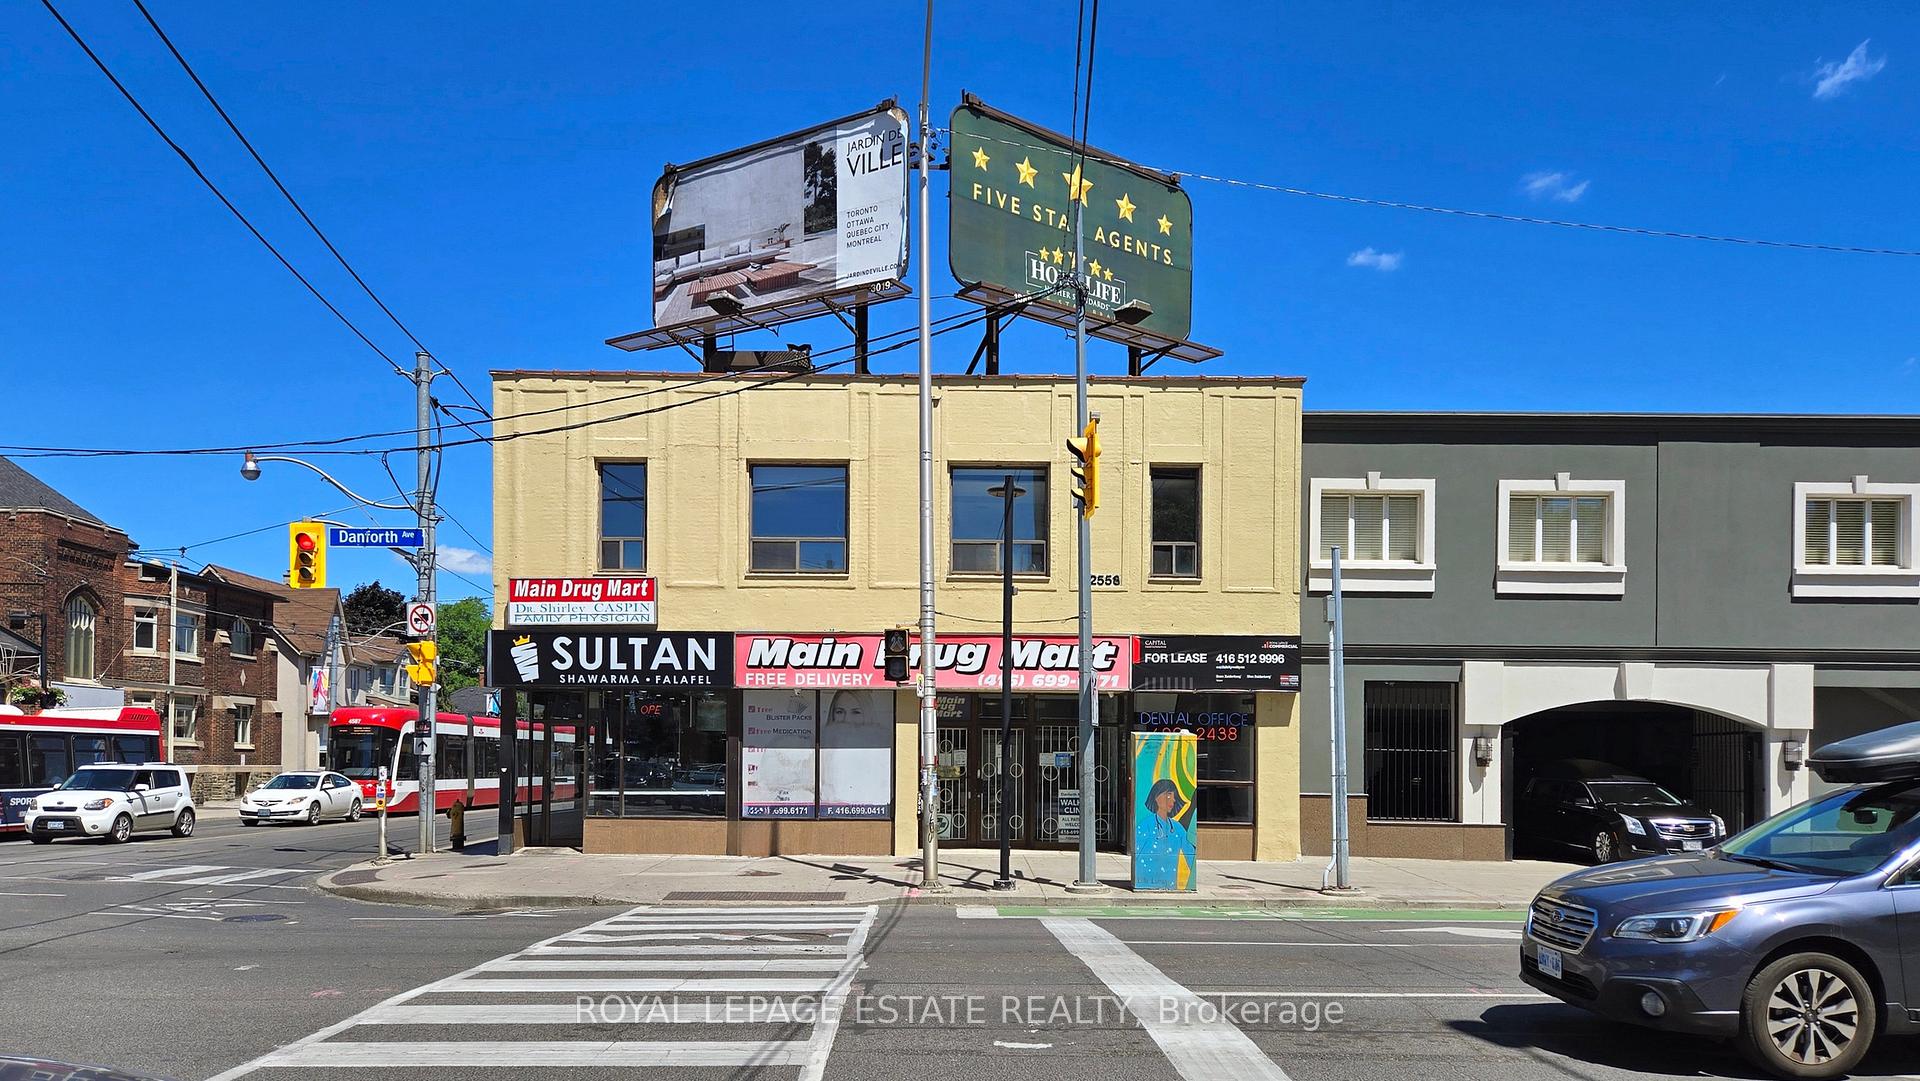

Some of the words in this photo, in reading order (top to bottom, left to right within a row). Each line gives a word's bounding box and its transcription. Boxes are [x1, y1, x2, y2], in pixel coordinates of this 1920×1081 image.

[847, 133, 885, 156] JARDIN
[847, 143, 902, 177] VILLE
[847, 205, 878, 218] TORONTO
[847, 216, 874, 228] OTTAWA
[973, 182, 1020, 215] FIVE
[1033, 204, 1071, 232] STA
[1095, 226, 1173, 266] AGENTS.
[847, 226, 873, 239] QUEBEC
[875, 222, 889, 232] CITY
[846, 235, 881, 248] MONTREAL
[870, 281, 890, 292] 3019
[1031, 258, 1120, 304] HOLIFE
[339, 530, 398, 543] Danforth
[514, 580, 556, 597] Main
[561, 580, 602, 601] Drug
[607, 579, 648, 597] Mart
[594, 602, 650, 613] CASPIN
[514, 614, 567, 622] FAMILY
[569, 614, 650, 622] PHYSICIAN
[551, 636, 716, 671] SULTAN
[747, 637, 863, 669] Main
[1144, 653, 1168, 663] FOR
[1170, 653, 1208, 663] LEASE
[1216, 654, 1235, 664] 416
[1237, 654, 1257, 663] 512
[1259, 654, 1285, 664] 9996
[559, 674, 640, 684] SHAWARMA
[655, 675, 711, 684] FALAFEL
[745, 673, 787, 685] FREE
[795, 673, 873, 685] DELIVERY
[1031, 675, 1120, 687] 699-71
[1140, 712, 1193, 725] DENTAL
[1198, 713, 1248, 726] OFFICE
[835, 807, 885, 815] 416.699.0411
